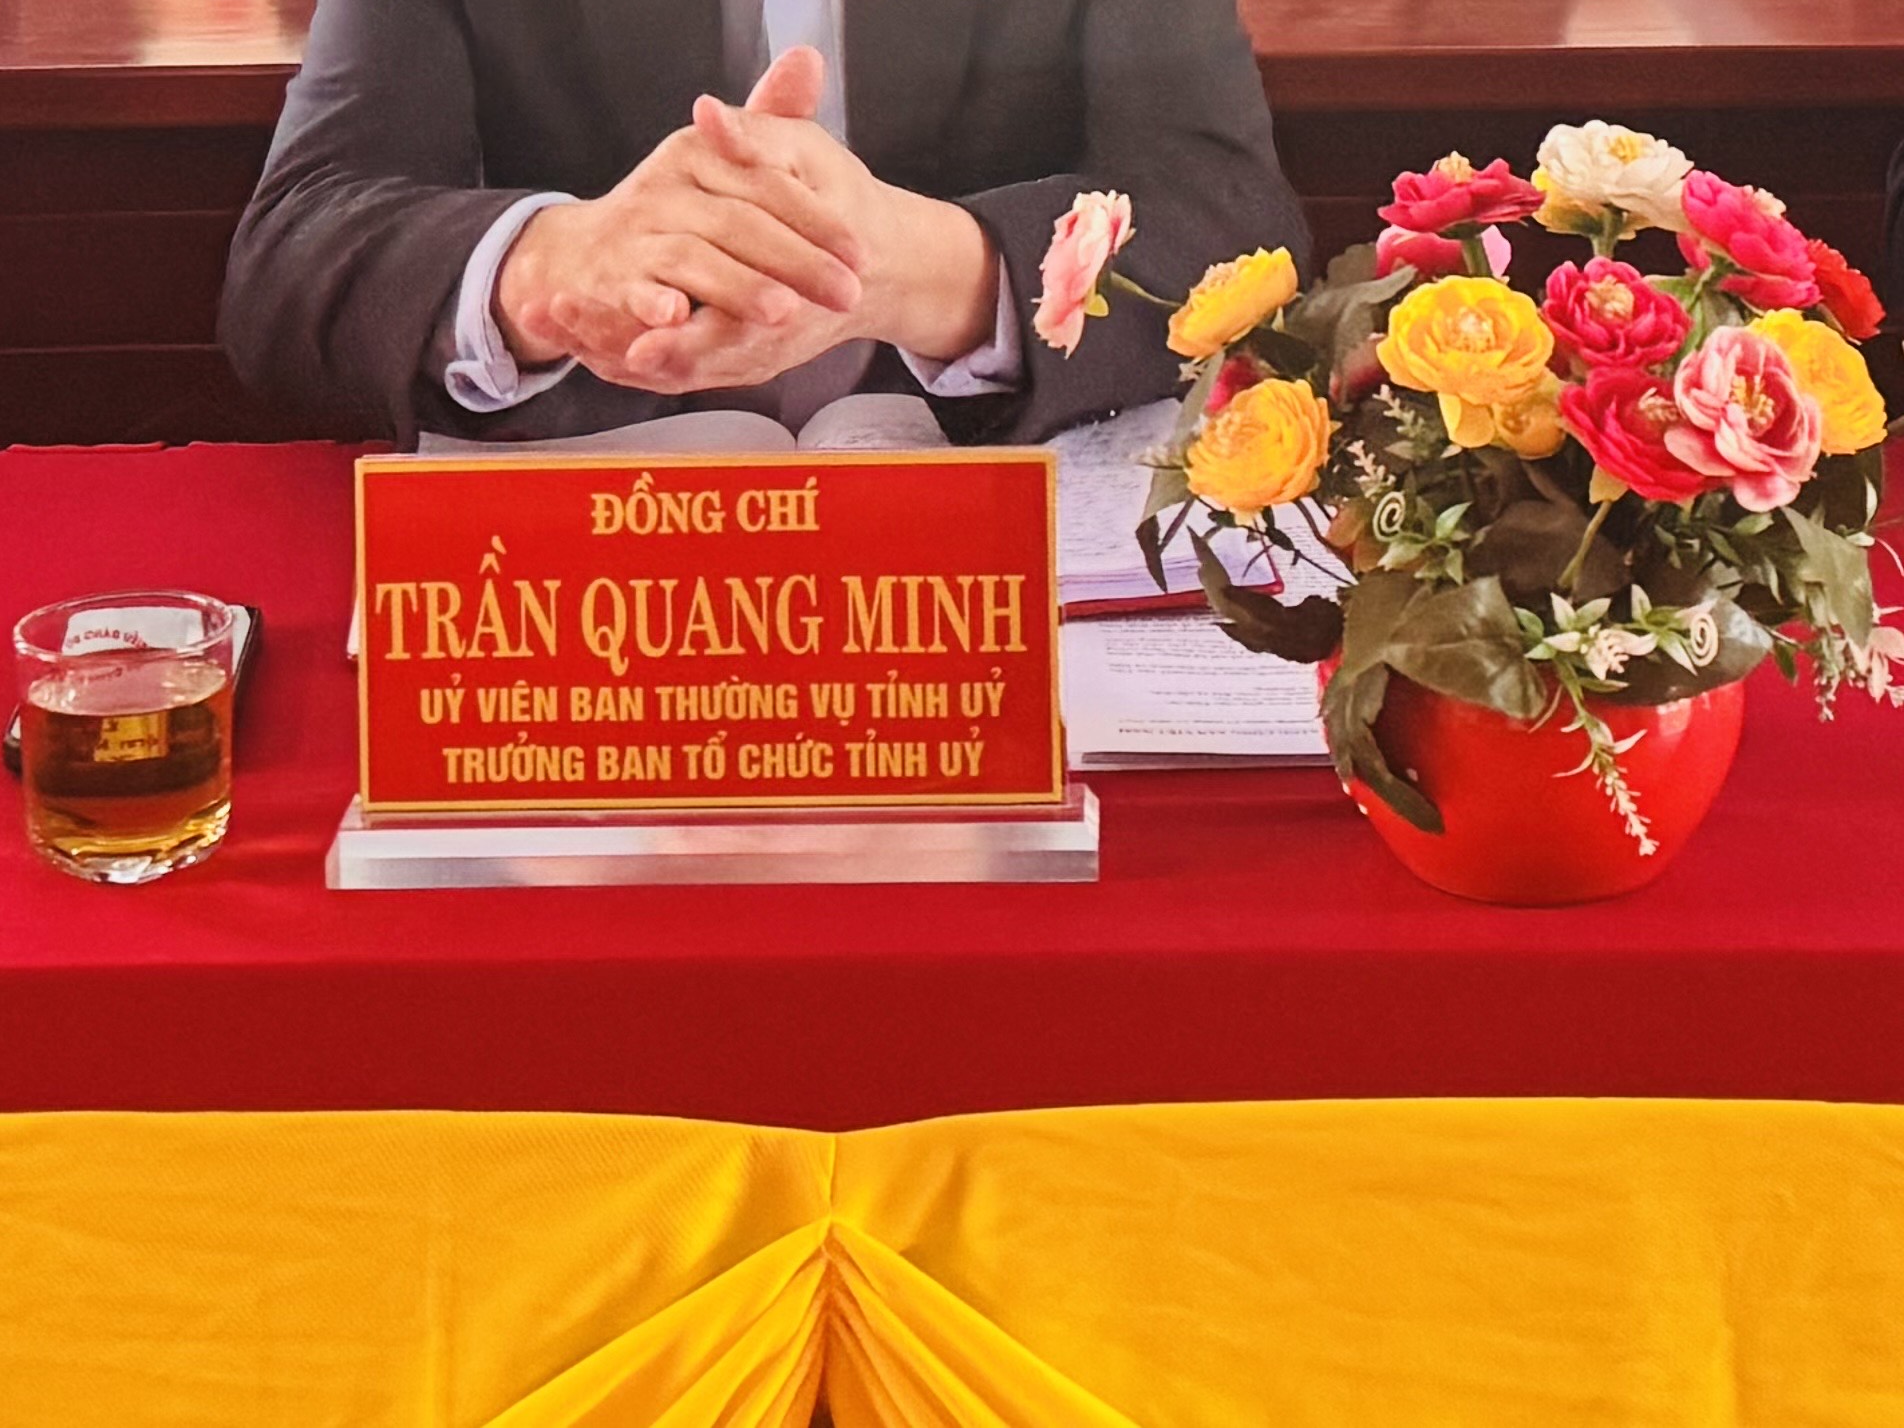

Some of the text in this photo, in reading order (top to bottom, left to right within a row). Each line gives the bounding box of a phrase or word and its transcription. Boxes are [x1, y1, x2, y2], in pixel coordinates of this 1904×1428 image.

[591, 472, 819, 534] ĐỒNG CHÍ
[376, 536, 1027, 676] TRẦN QUANG MINH
[477, 680, 557, 722] VIÊN
[570, 687, 643, 721] BAN
[655, 676, 798, 720] THƯỜNG
[810, 683, 854, 726] VỤ
[866, 670, 948, 718] TỈNH
[443, 732, 584, 783] TRƯỞNG
[598, 746, 671, 780] BAN
[682, 731, 727, 779] TỔ
[739, 733, 833, 779] CHỨC
[845, 729, 927, 777] TỈNH
